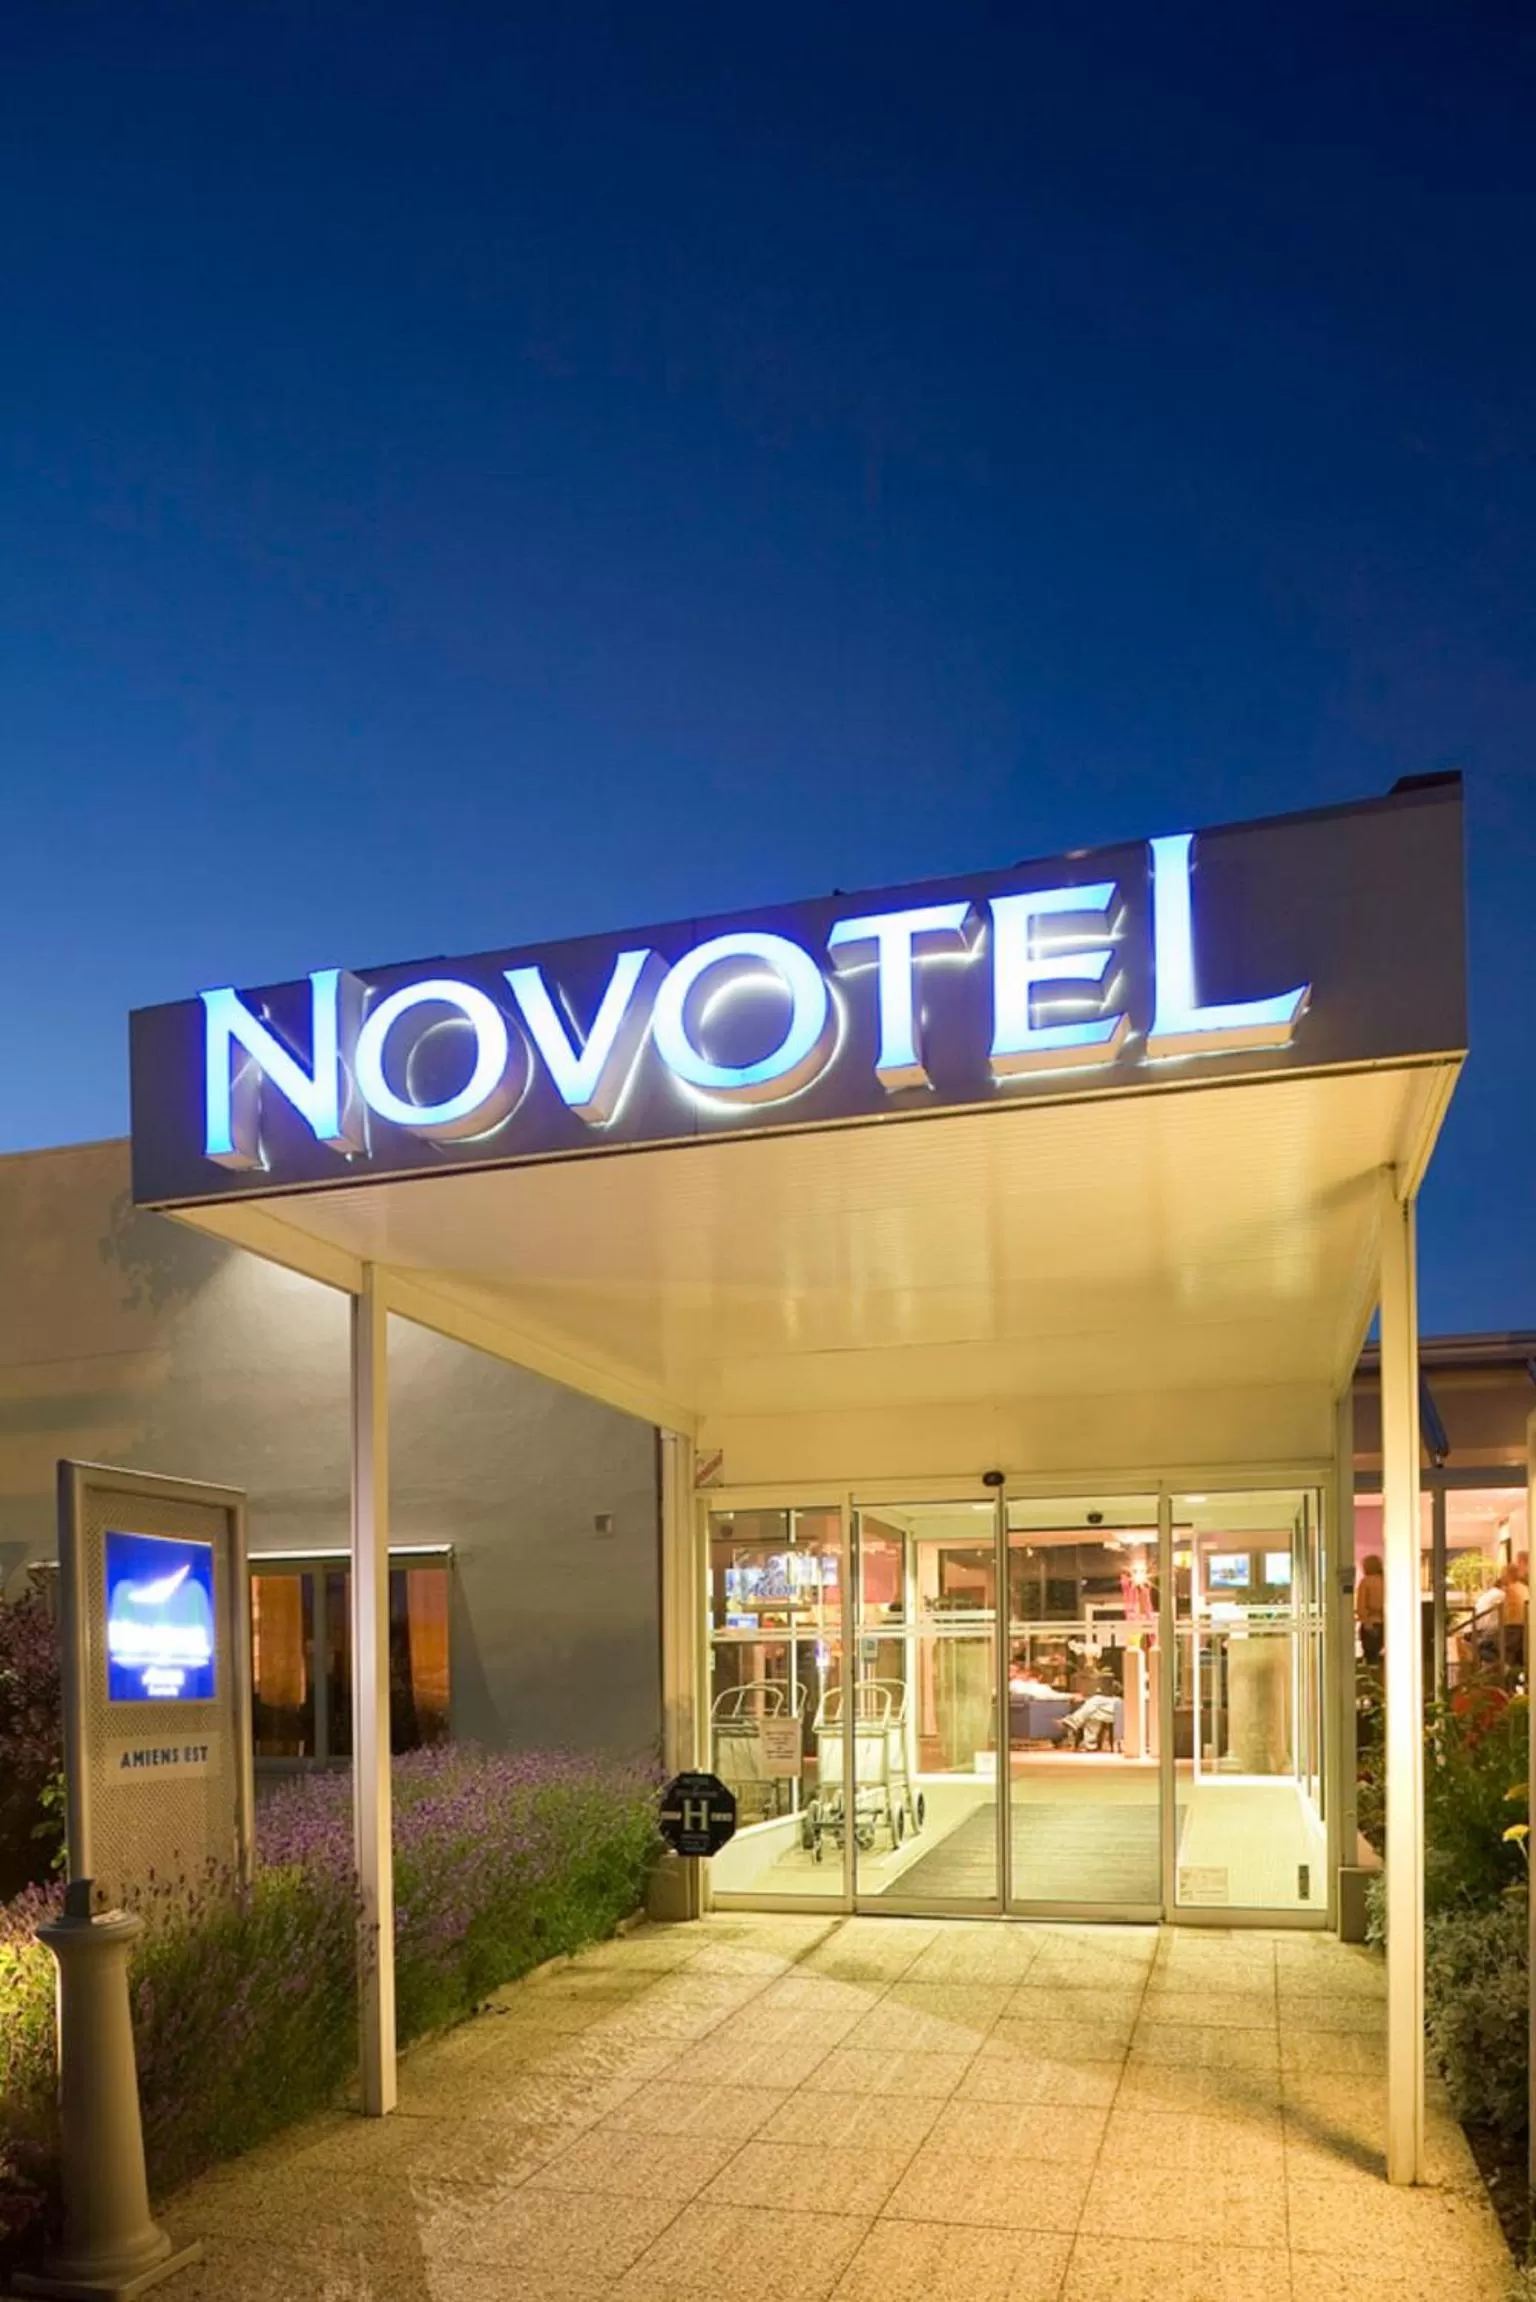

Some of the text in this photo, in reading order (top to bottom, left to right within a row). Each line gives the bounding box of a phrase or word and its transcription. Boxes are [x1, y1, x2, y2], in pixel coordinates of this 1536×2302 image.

[201, 833, 1309, 1160] NOVOTEL
[120, 1745, 209, 1769] AMIENS EST
[683, 1799, 709, 1831] H
